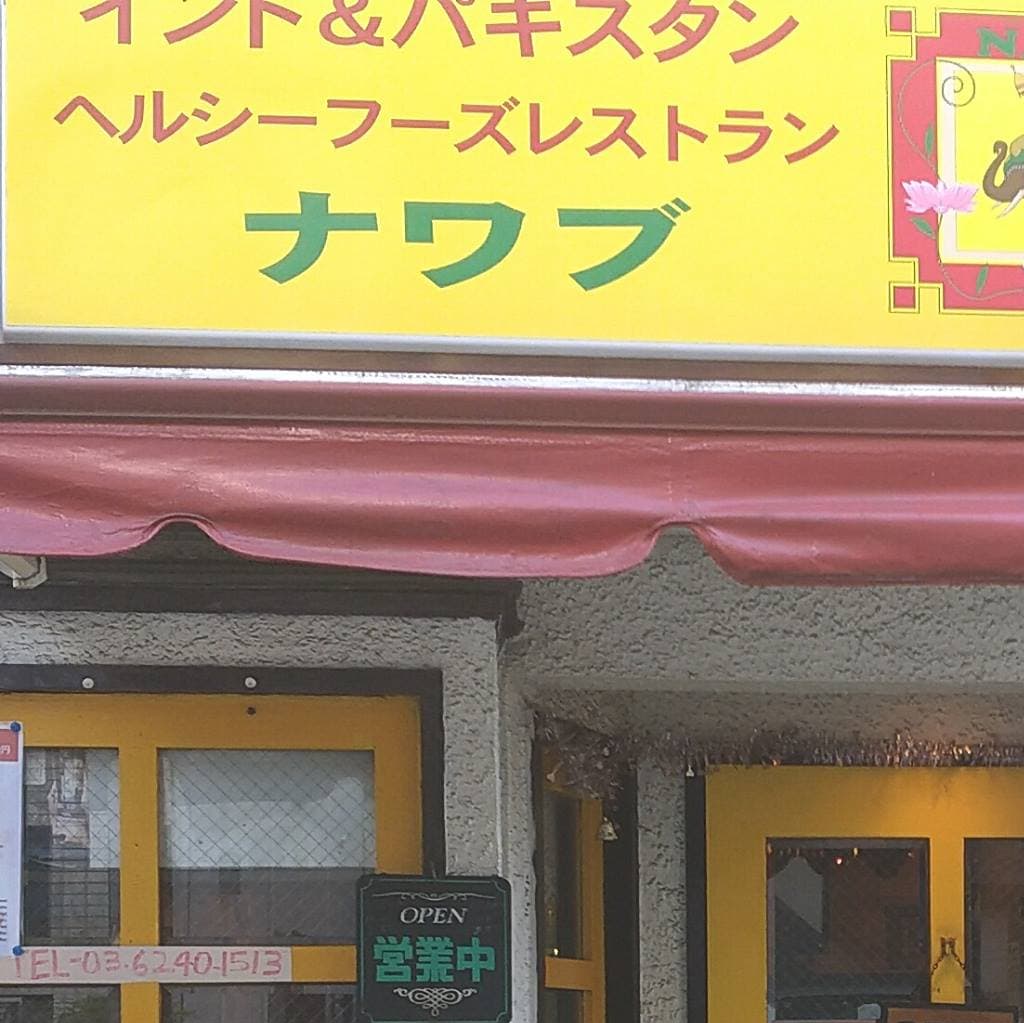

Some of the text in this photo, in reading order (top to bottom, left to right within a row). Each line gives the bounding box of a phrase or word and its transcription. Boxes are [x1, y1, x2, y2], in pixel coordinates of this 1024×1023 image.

[54, 90, 840, 165] ヘルシーフーズレストラン
[244, 191, 691, 291] ナワブ
[400, 905, 468, 926] OPEN
[373, 935, 496, 983] 営業中
